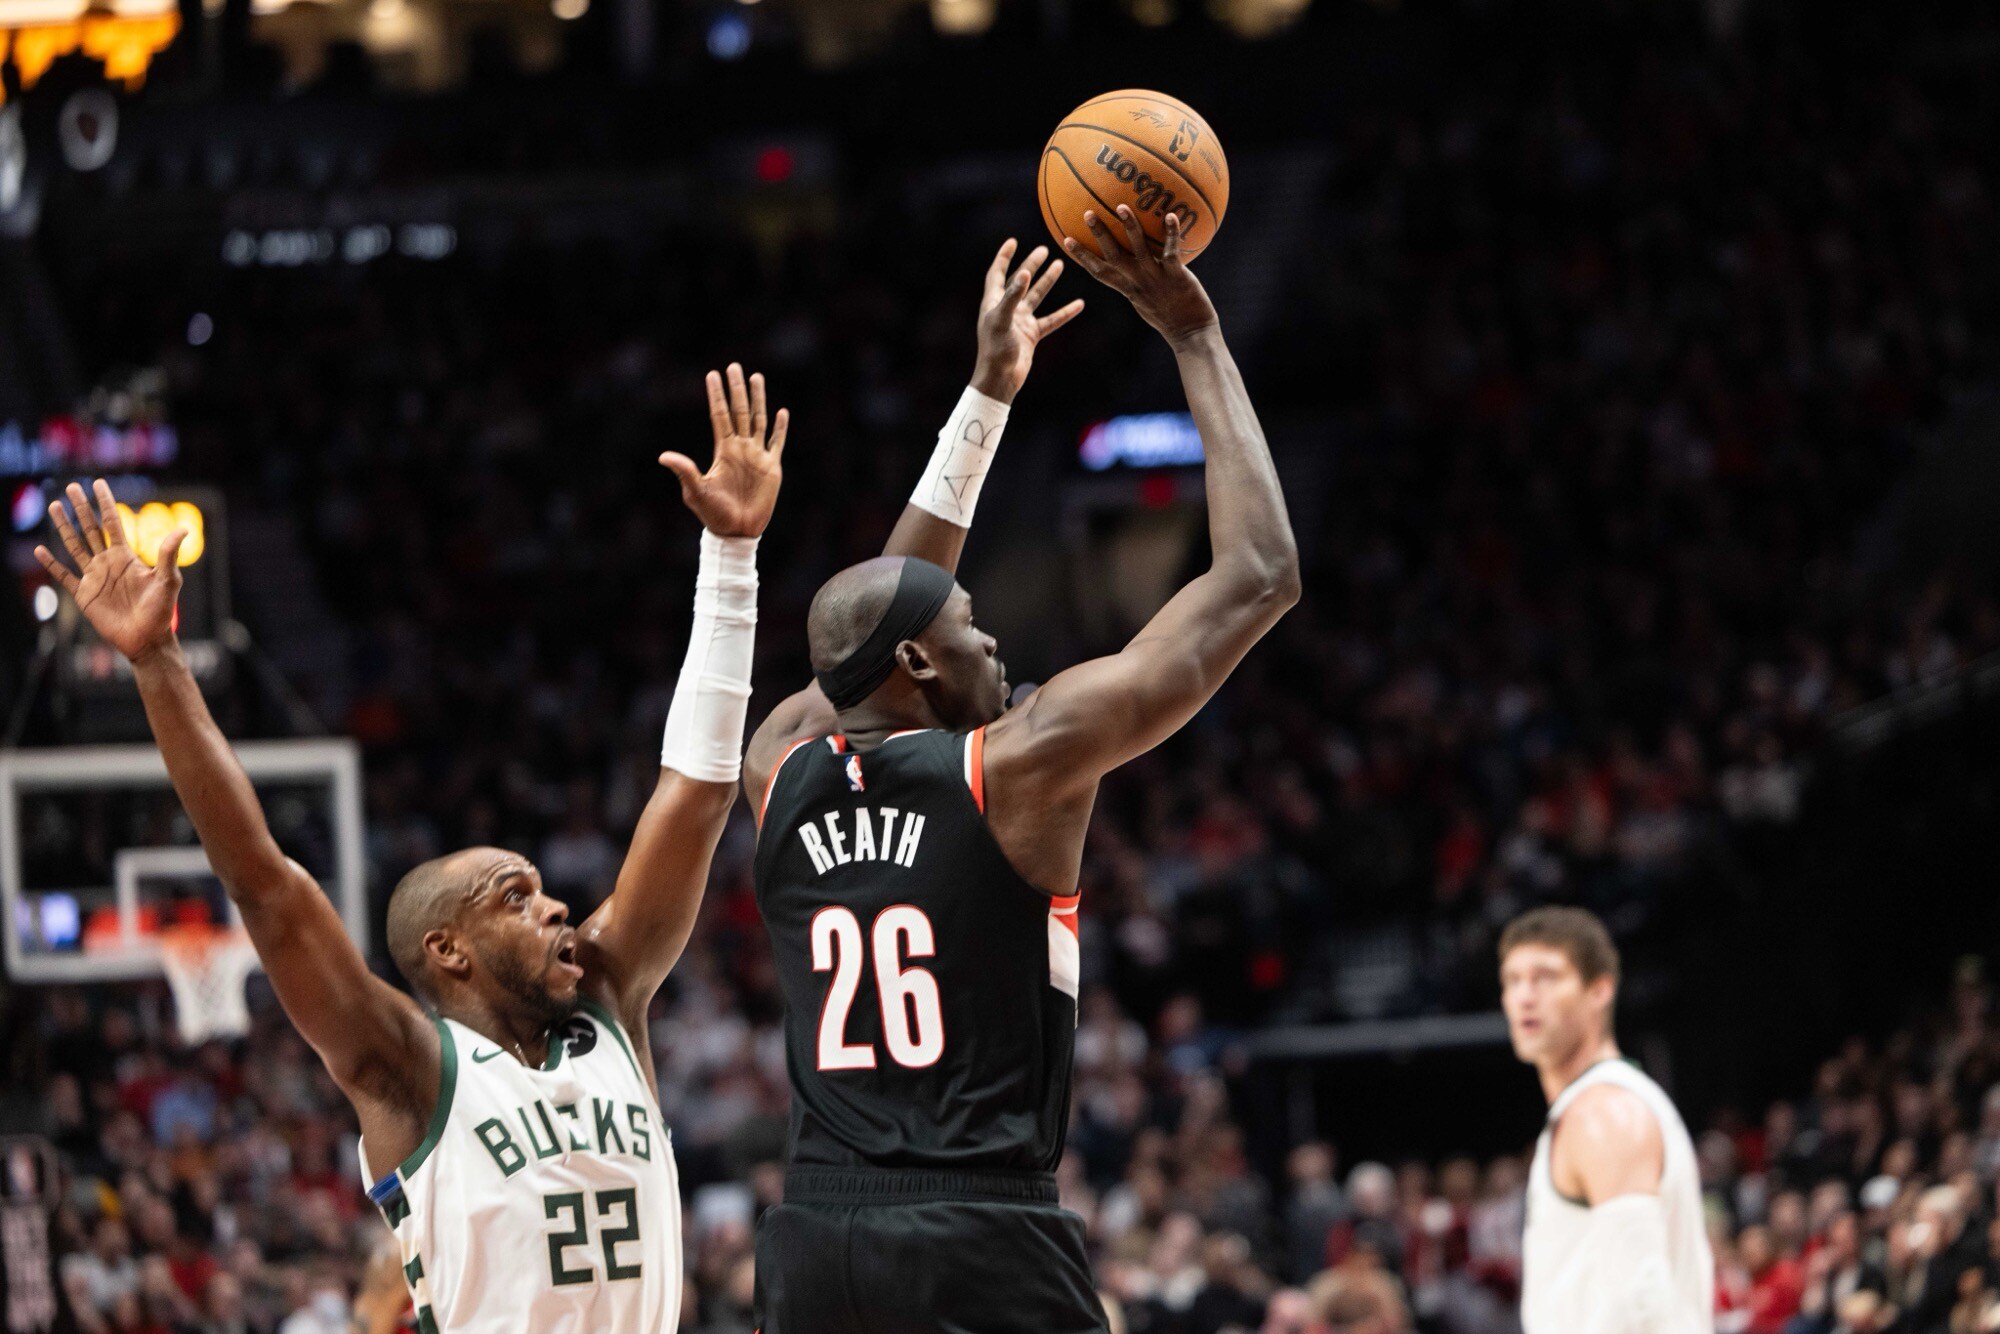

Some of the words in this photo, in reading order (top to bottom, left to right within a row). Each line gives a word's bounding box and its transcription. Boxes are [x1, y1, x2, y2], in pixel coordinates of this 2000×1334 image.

[798, 806, 926, 876] REATH
[810, 903, 945, 1072] 26
[542, 1187, 643, 1287] 22
